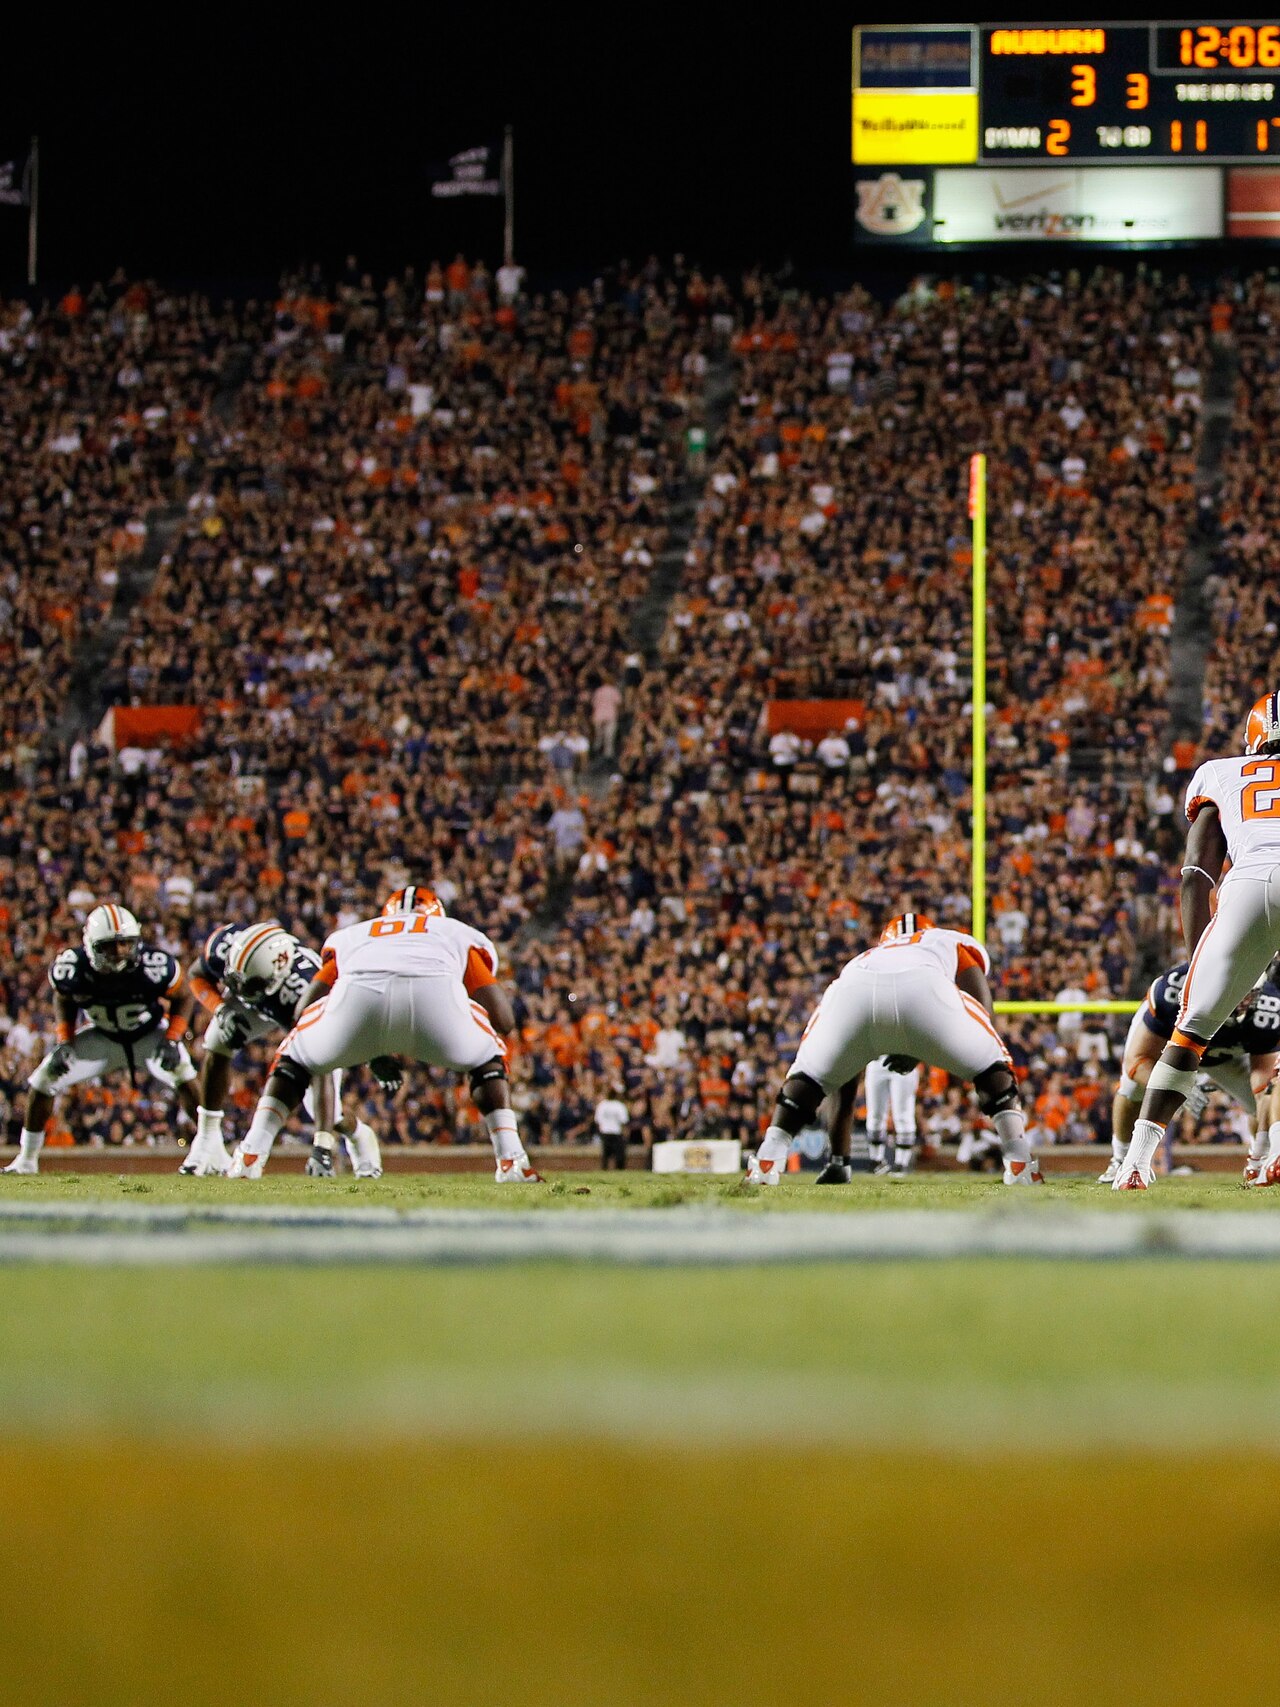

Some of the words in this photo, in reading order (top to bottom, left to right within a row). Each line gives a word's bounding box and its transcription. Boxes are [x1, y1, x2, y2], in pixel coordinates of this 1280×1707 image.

[1070, 64, 1096, 107] 3
[1126, 73, 1149, 110] 3
[1045, 118, 1072, 156] 2
[1169, 119, 1208, 152] 11
[52, 948, 79, 981] 46
[142, 951, 168, 984] 46
